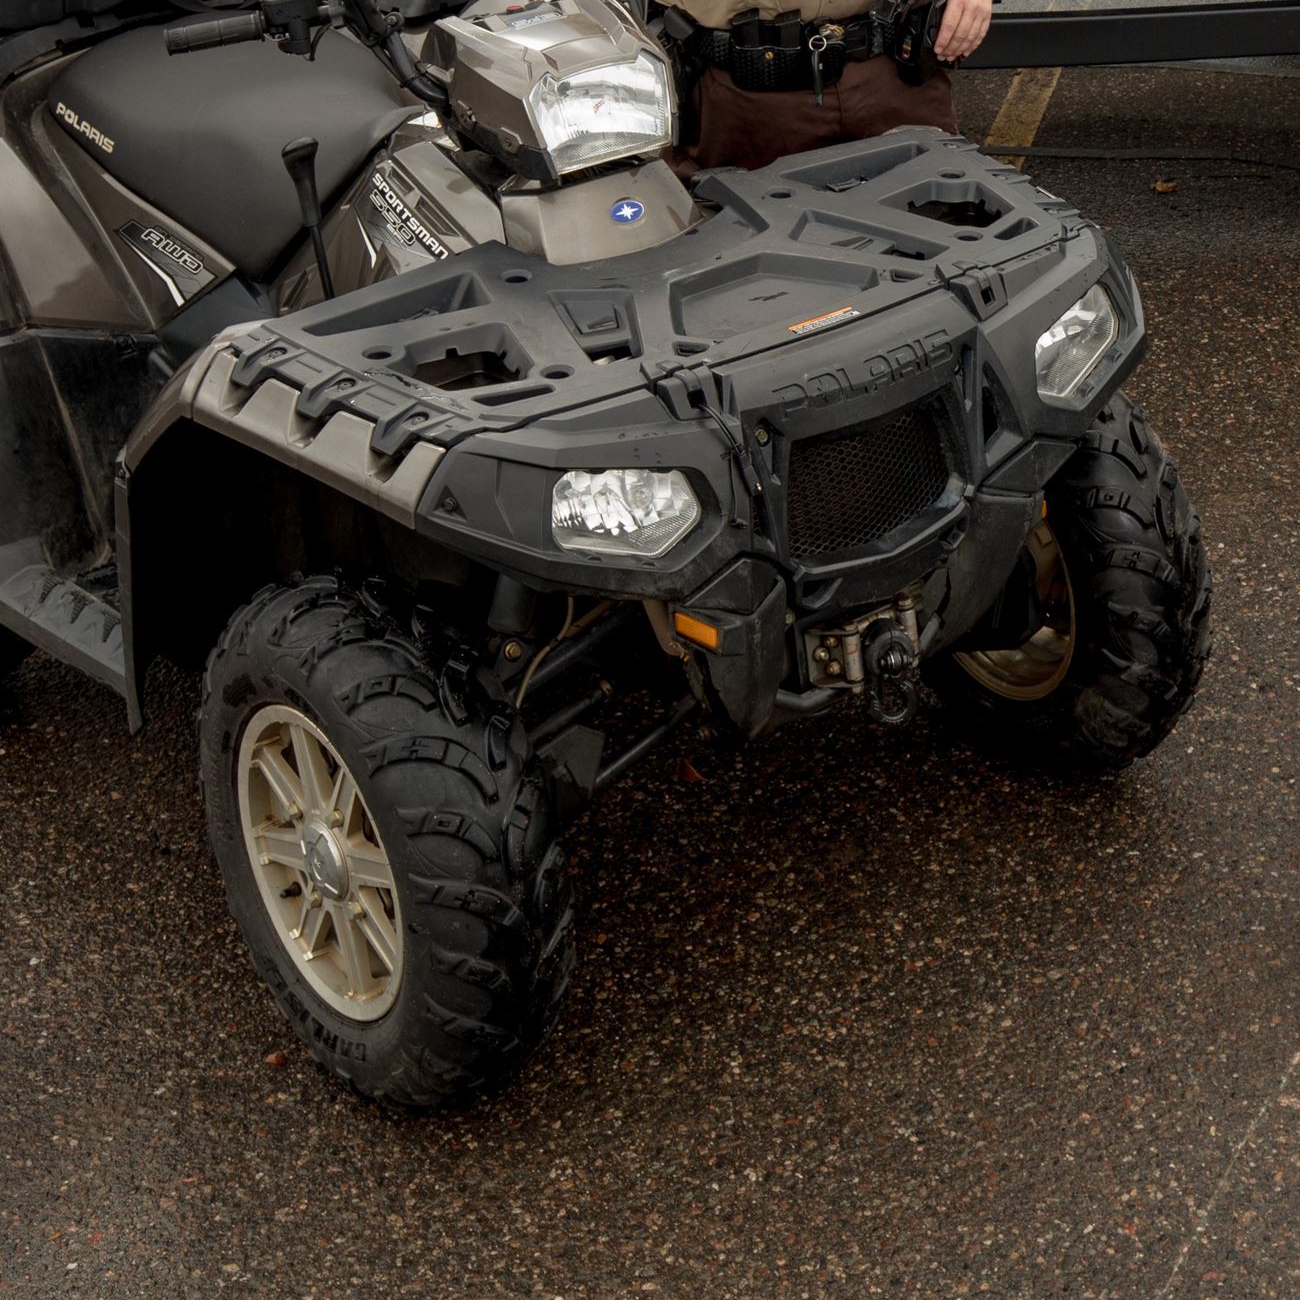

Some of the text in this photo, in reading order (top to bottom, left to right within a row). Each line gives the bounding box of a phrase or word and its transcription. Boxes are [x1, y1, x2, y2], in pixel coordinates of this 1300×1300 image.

[56, 102, 115, 153] POLARIS
[369, 188, 416, 245] 550
[372, 173, 449, 260] SPORTSMAN
[141, 228, 204, 274] AWD
[771, 329, 954, 423] POLARIS
